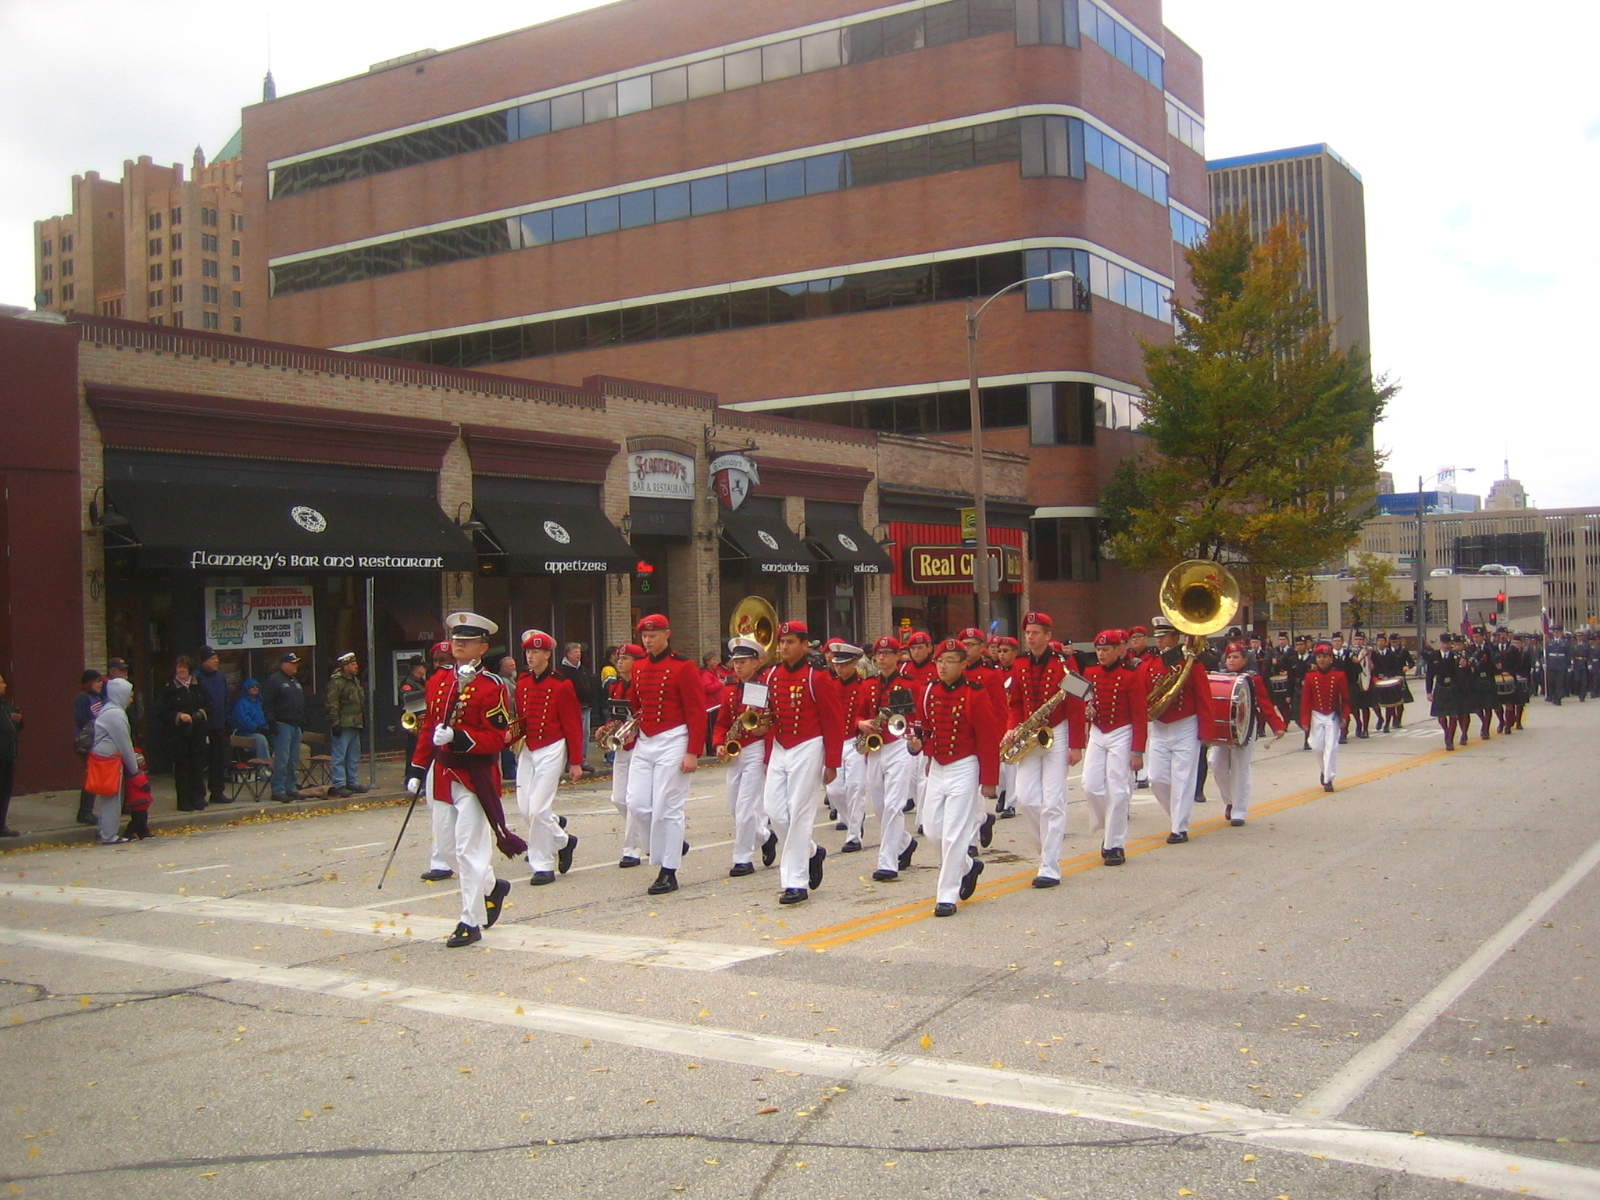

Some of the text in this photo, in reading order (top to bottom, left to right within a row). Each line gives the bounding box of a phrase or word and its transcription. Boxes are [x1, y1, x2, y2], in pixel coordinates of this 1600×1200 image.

[632, 481, 690, 494] BAR & RESTAURANT
[761, 562, 810, 573] sandwiches
[853, 563, 879, 573] salads
[920, 554, 955, 576] Real
